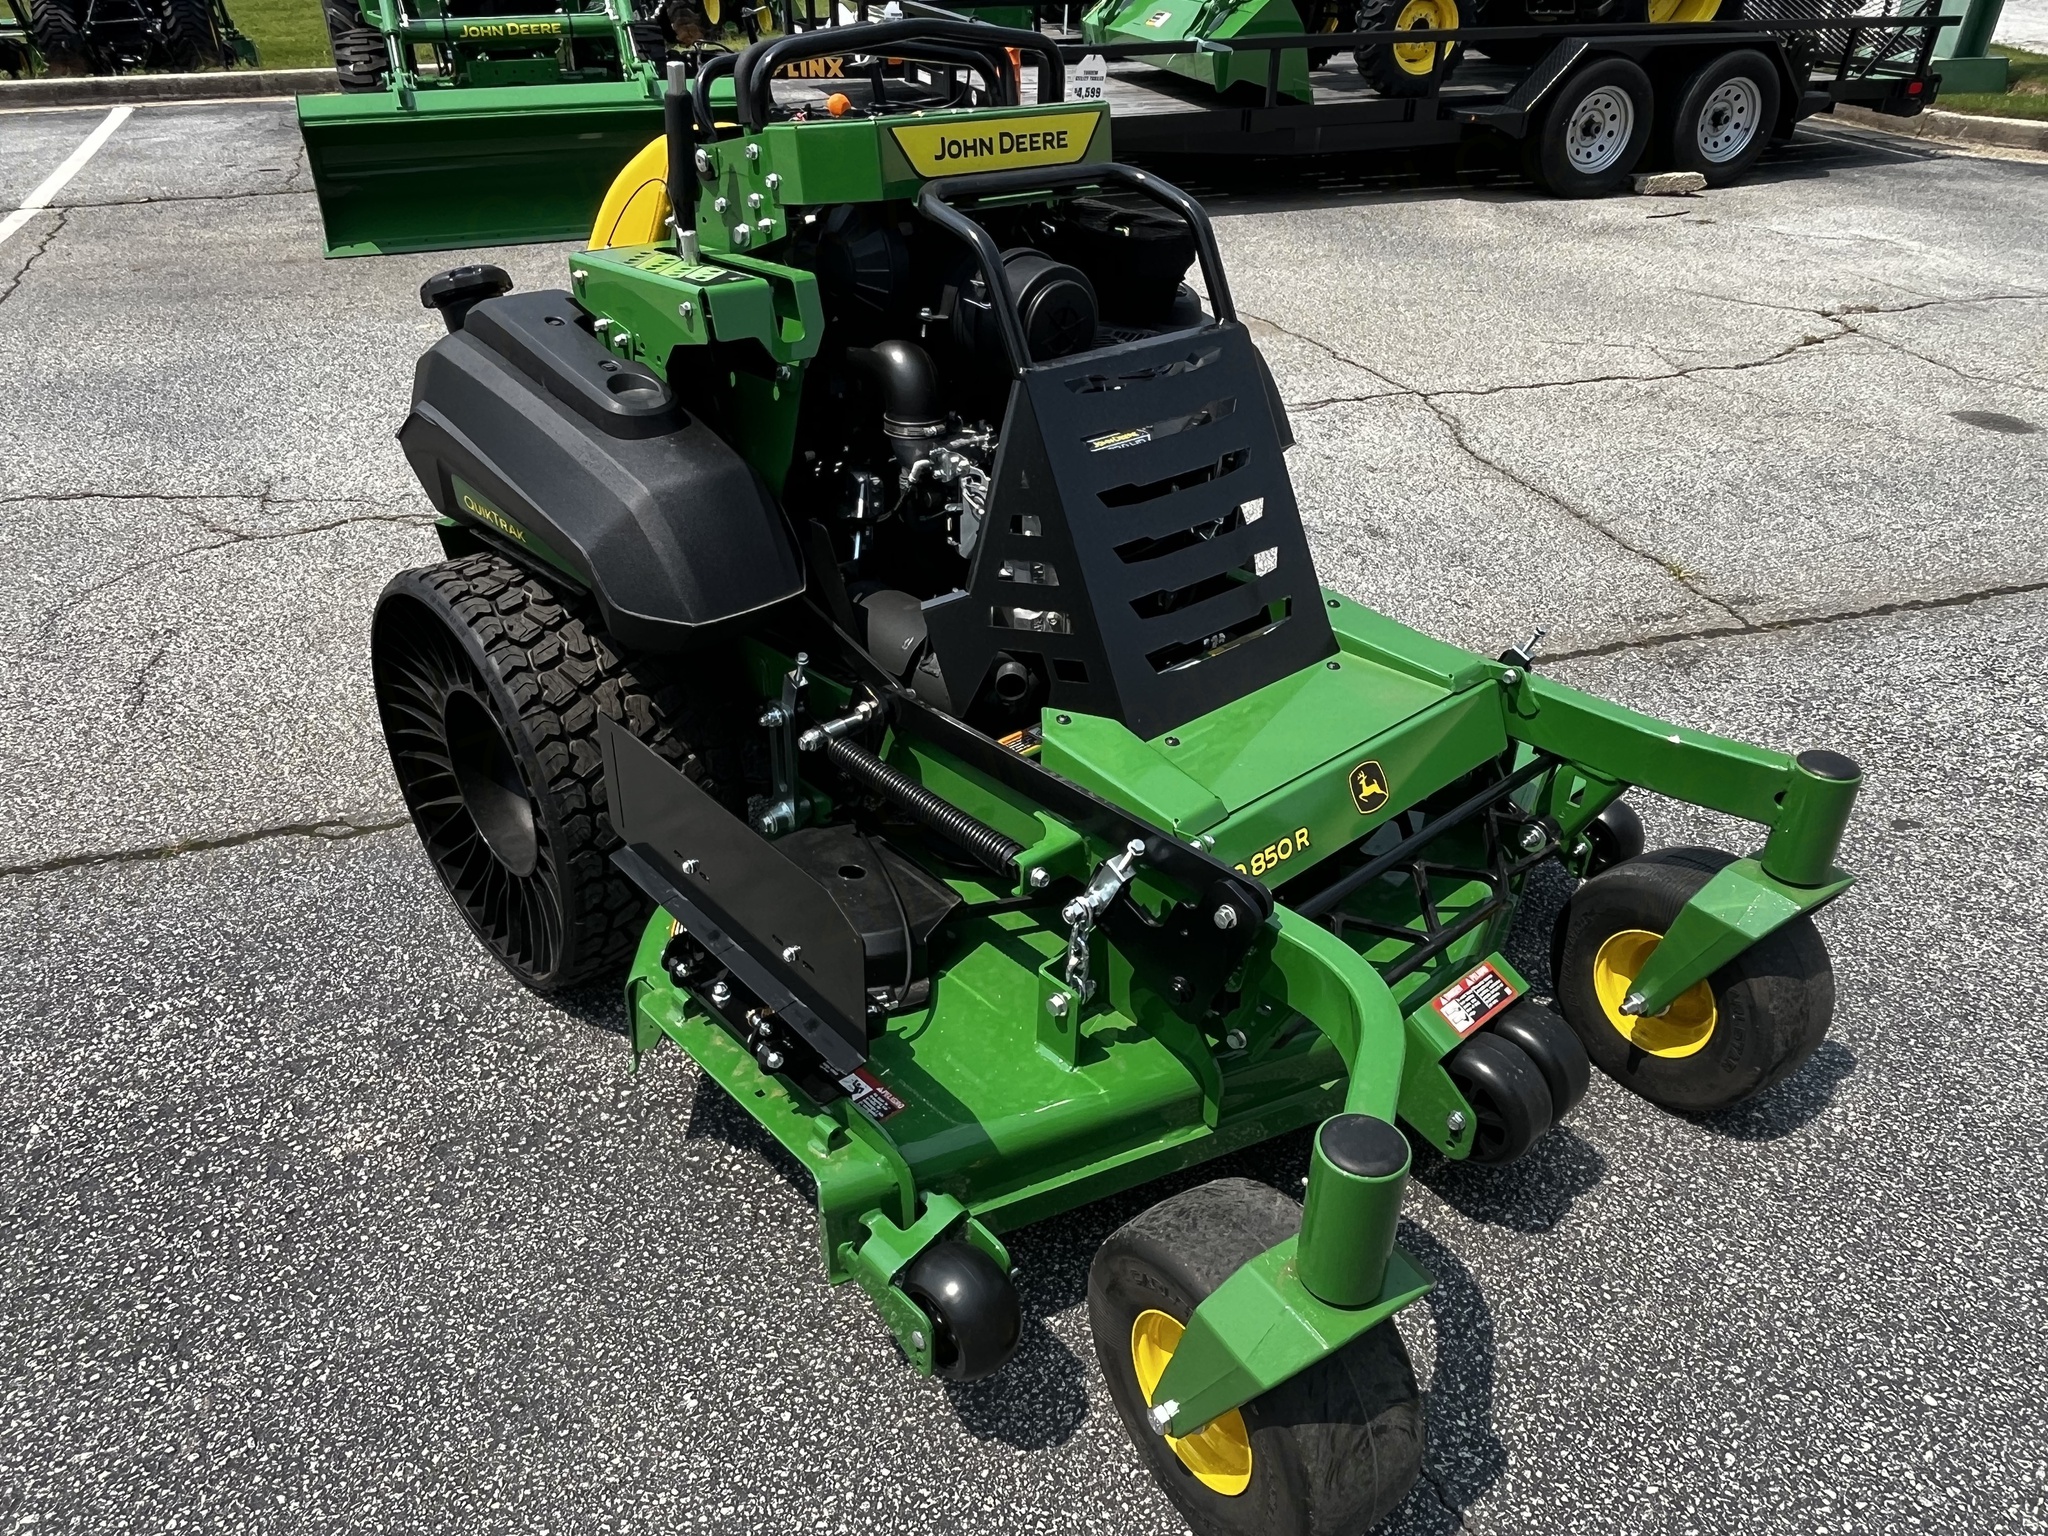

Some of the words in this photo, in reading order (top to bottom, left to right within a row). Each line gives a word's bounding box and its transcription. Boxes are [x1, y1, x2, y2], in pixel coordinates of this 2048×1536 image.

[460, 25, 504, 38] JOHN
[506, 22, 562, 35] DEERE
[1074, 87, 1101, 99] $4,599
[934, 136, 994, 161] JOHN
[998, 130, 1068, 154] DEERE
[1250, 837, 1293, 876] 850
[1295, 827, 1310, 852] R
